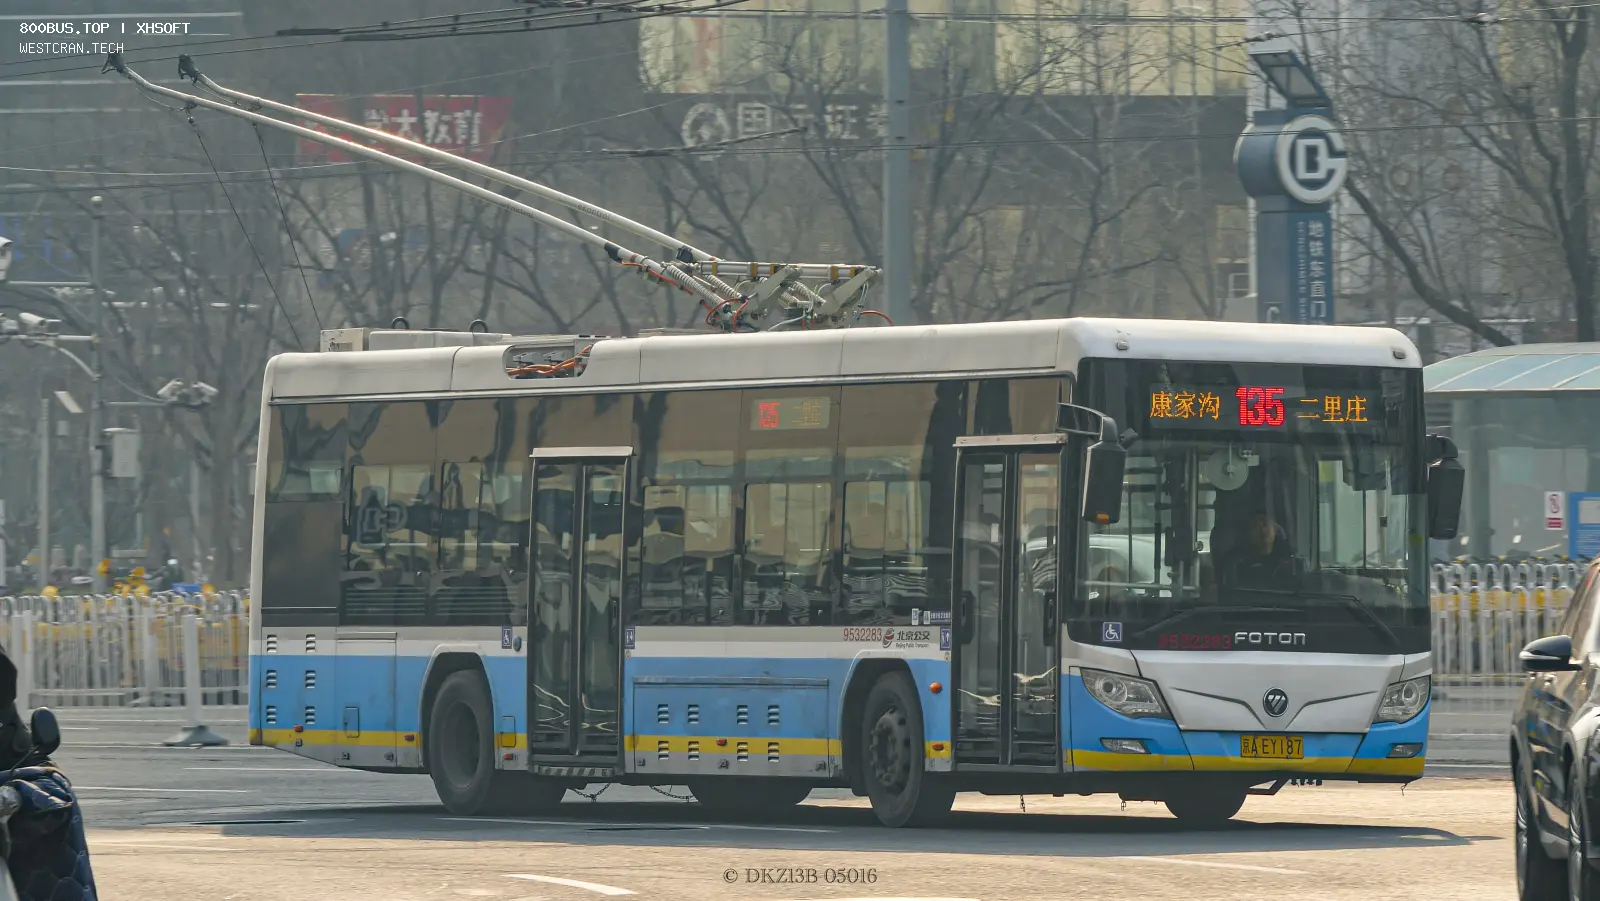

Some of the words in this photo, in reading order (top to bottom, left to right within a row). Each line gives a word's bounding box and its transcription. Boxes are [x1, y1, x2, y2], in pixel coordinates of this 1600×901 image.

[1308, 219, 1327, 324] 地铁东直门
[1150, 390, 1221, 421] 康家沟
[1235, 386, 1286, 426] 135
[1296, 394, 1368, 422] 二里庄
[843, 628, 882, 642] 9532283
[896, 630, 931, 640] 北京公交
[1234, 631, 1306, 646] FOTON
